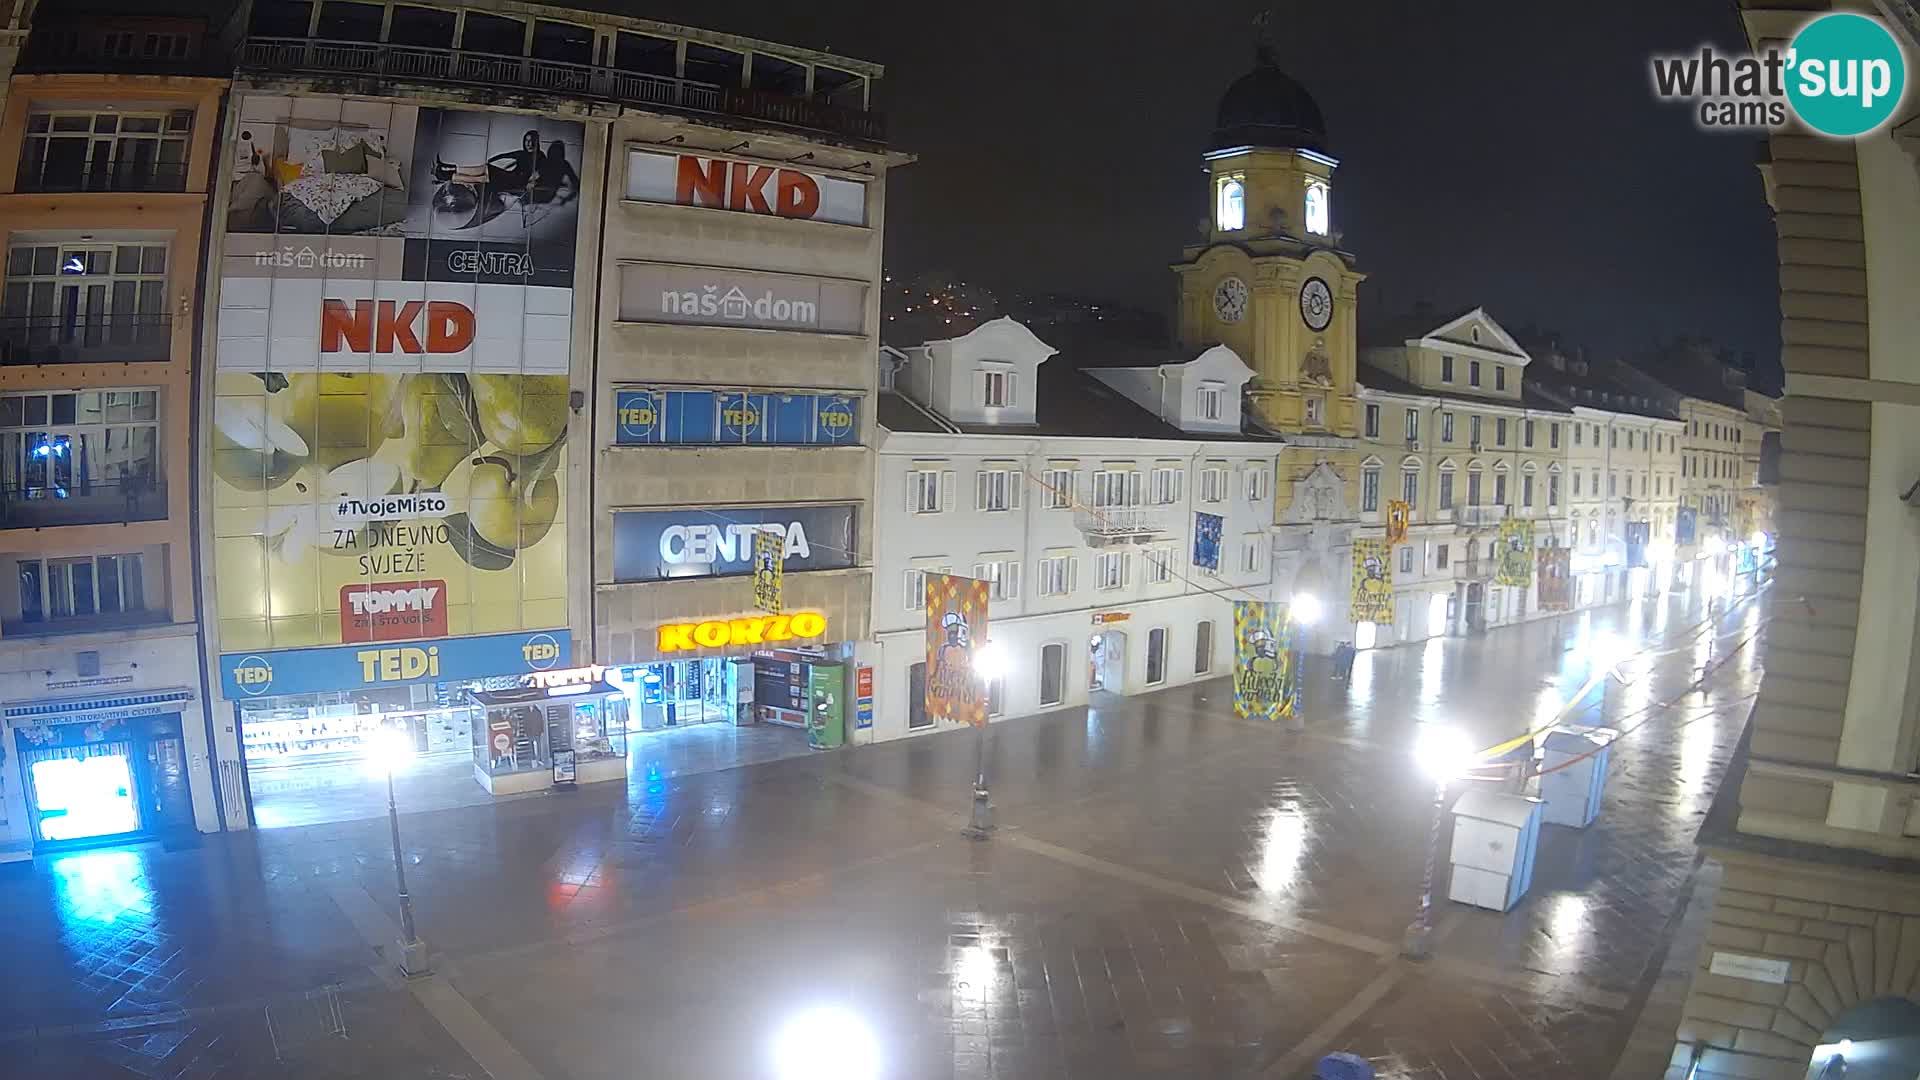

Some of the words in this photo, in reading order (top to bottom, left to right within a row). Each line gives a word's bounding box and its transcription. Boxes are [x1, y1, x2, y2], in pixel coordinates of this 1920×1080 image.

[676, 155, 820, 219] NKD
[255, 247, 294, 267] naš
[318, 248, 366, 268] dom
[448, 250, 535, 275] CENTRA
[661, 284, 718, 316] naš
[754, 290, 817, 323] dom
[321, 299, 476, 354] NKD
[619, 409, 657, 425] TEDi
[723, 410, 760, 426] TEDi
[820, 412, 853, 427] TEDi
[338, 498, 446, 517] #TvojeMisto
[333, 529, 357, 549] ZA
[367, 524, 450, 548] DNEVNO
[359, 548, 425, 575] SVJEŽE
[348, 587, 439, 615] TOMMY
[657, 612, 827, 652] KORZO
[522, 642, 561, 661] TEDi
[233, 666, 273, 685] TEDi
[357, 646, 440, 683] TEDi
